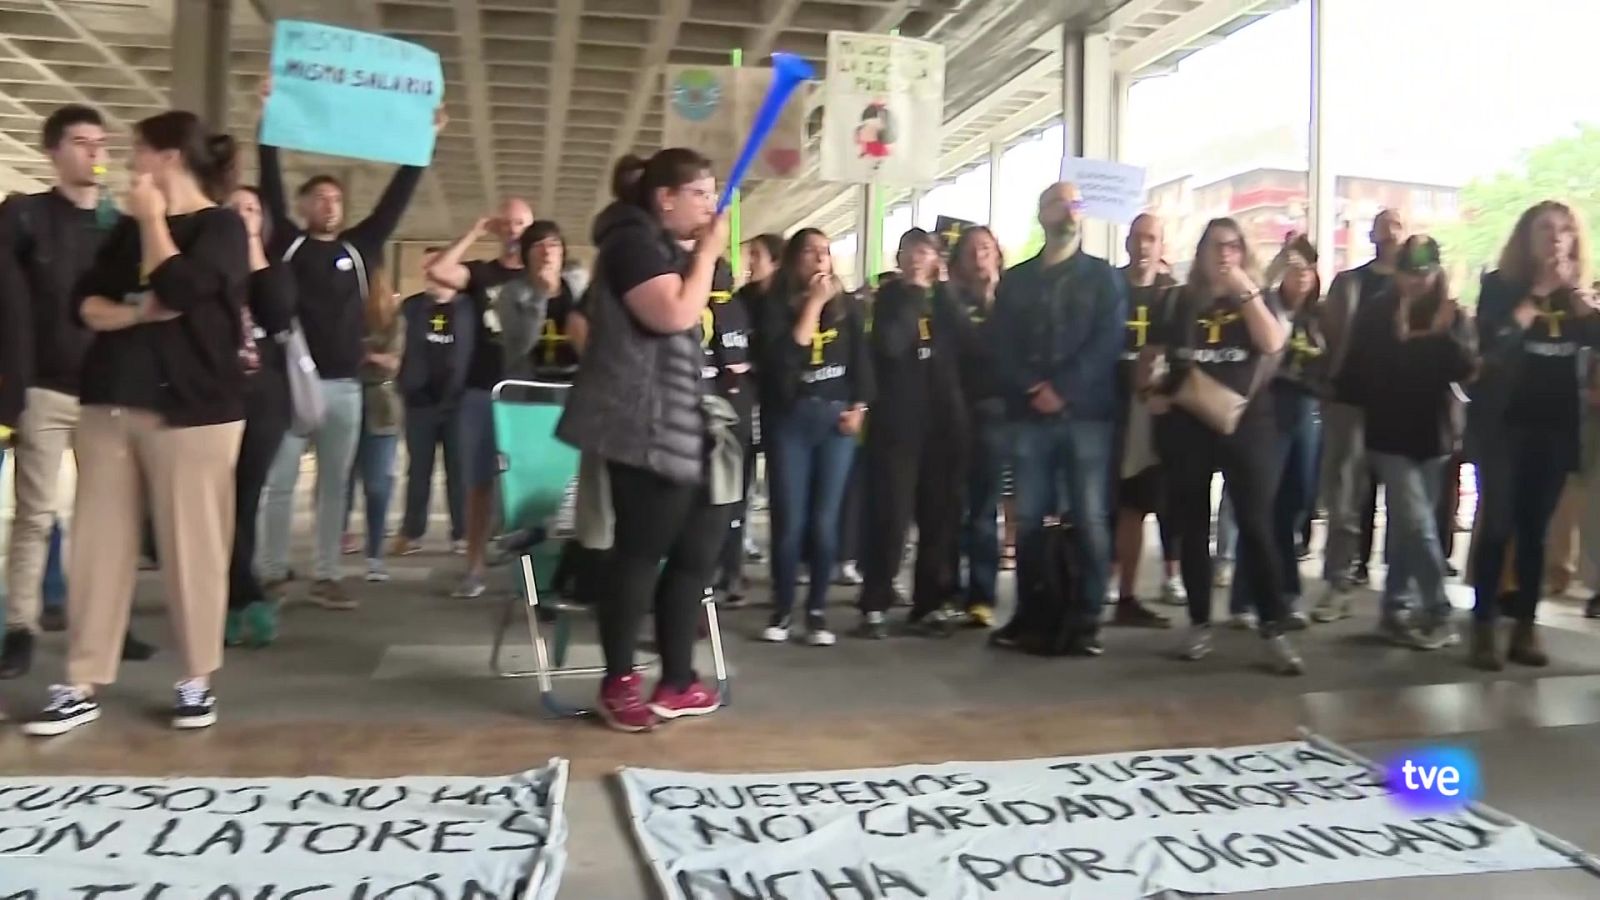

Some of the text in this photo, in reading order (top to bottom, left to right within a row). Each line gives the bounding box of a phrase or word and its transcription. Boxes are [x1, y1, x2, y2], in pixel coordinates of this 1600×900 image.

[649, 749, 1347, 810] QUEREMOS JUSTICIA
[144, 810, 547, 856] LATORES
[690, 814, 815, 846] NO
[958, 847, 1139, 892] POR
[1153, 817, 1491, 873] DIGNIDAD
